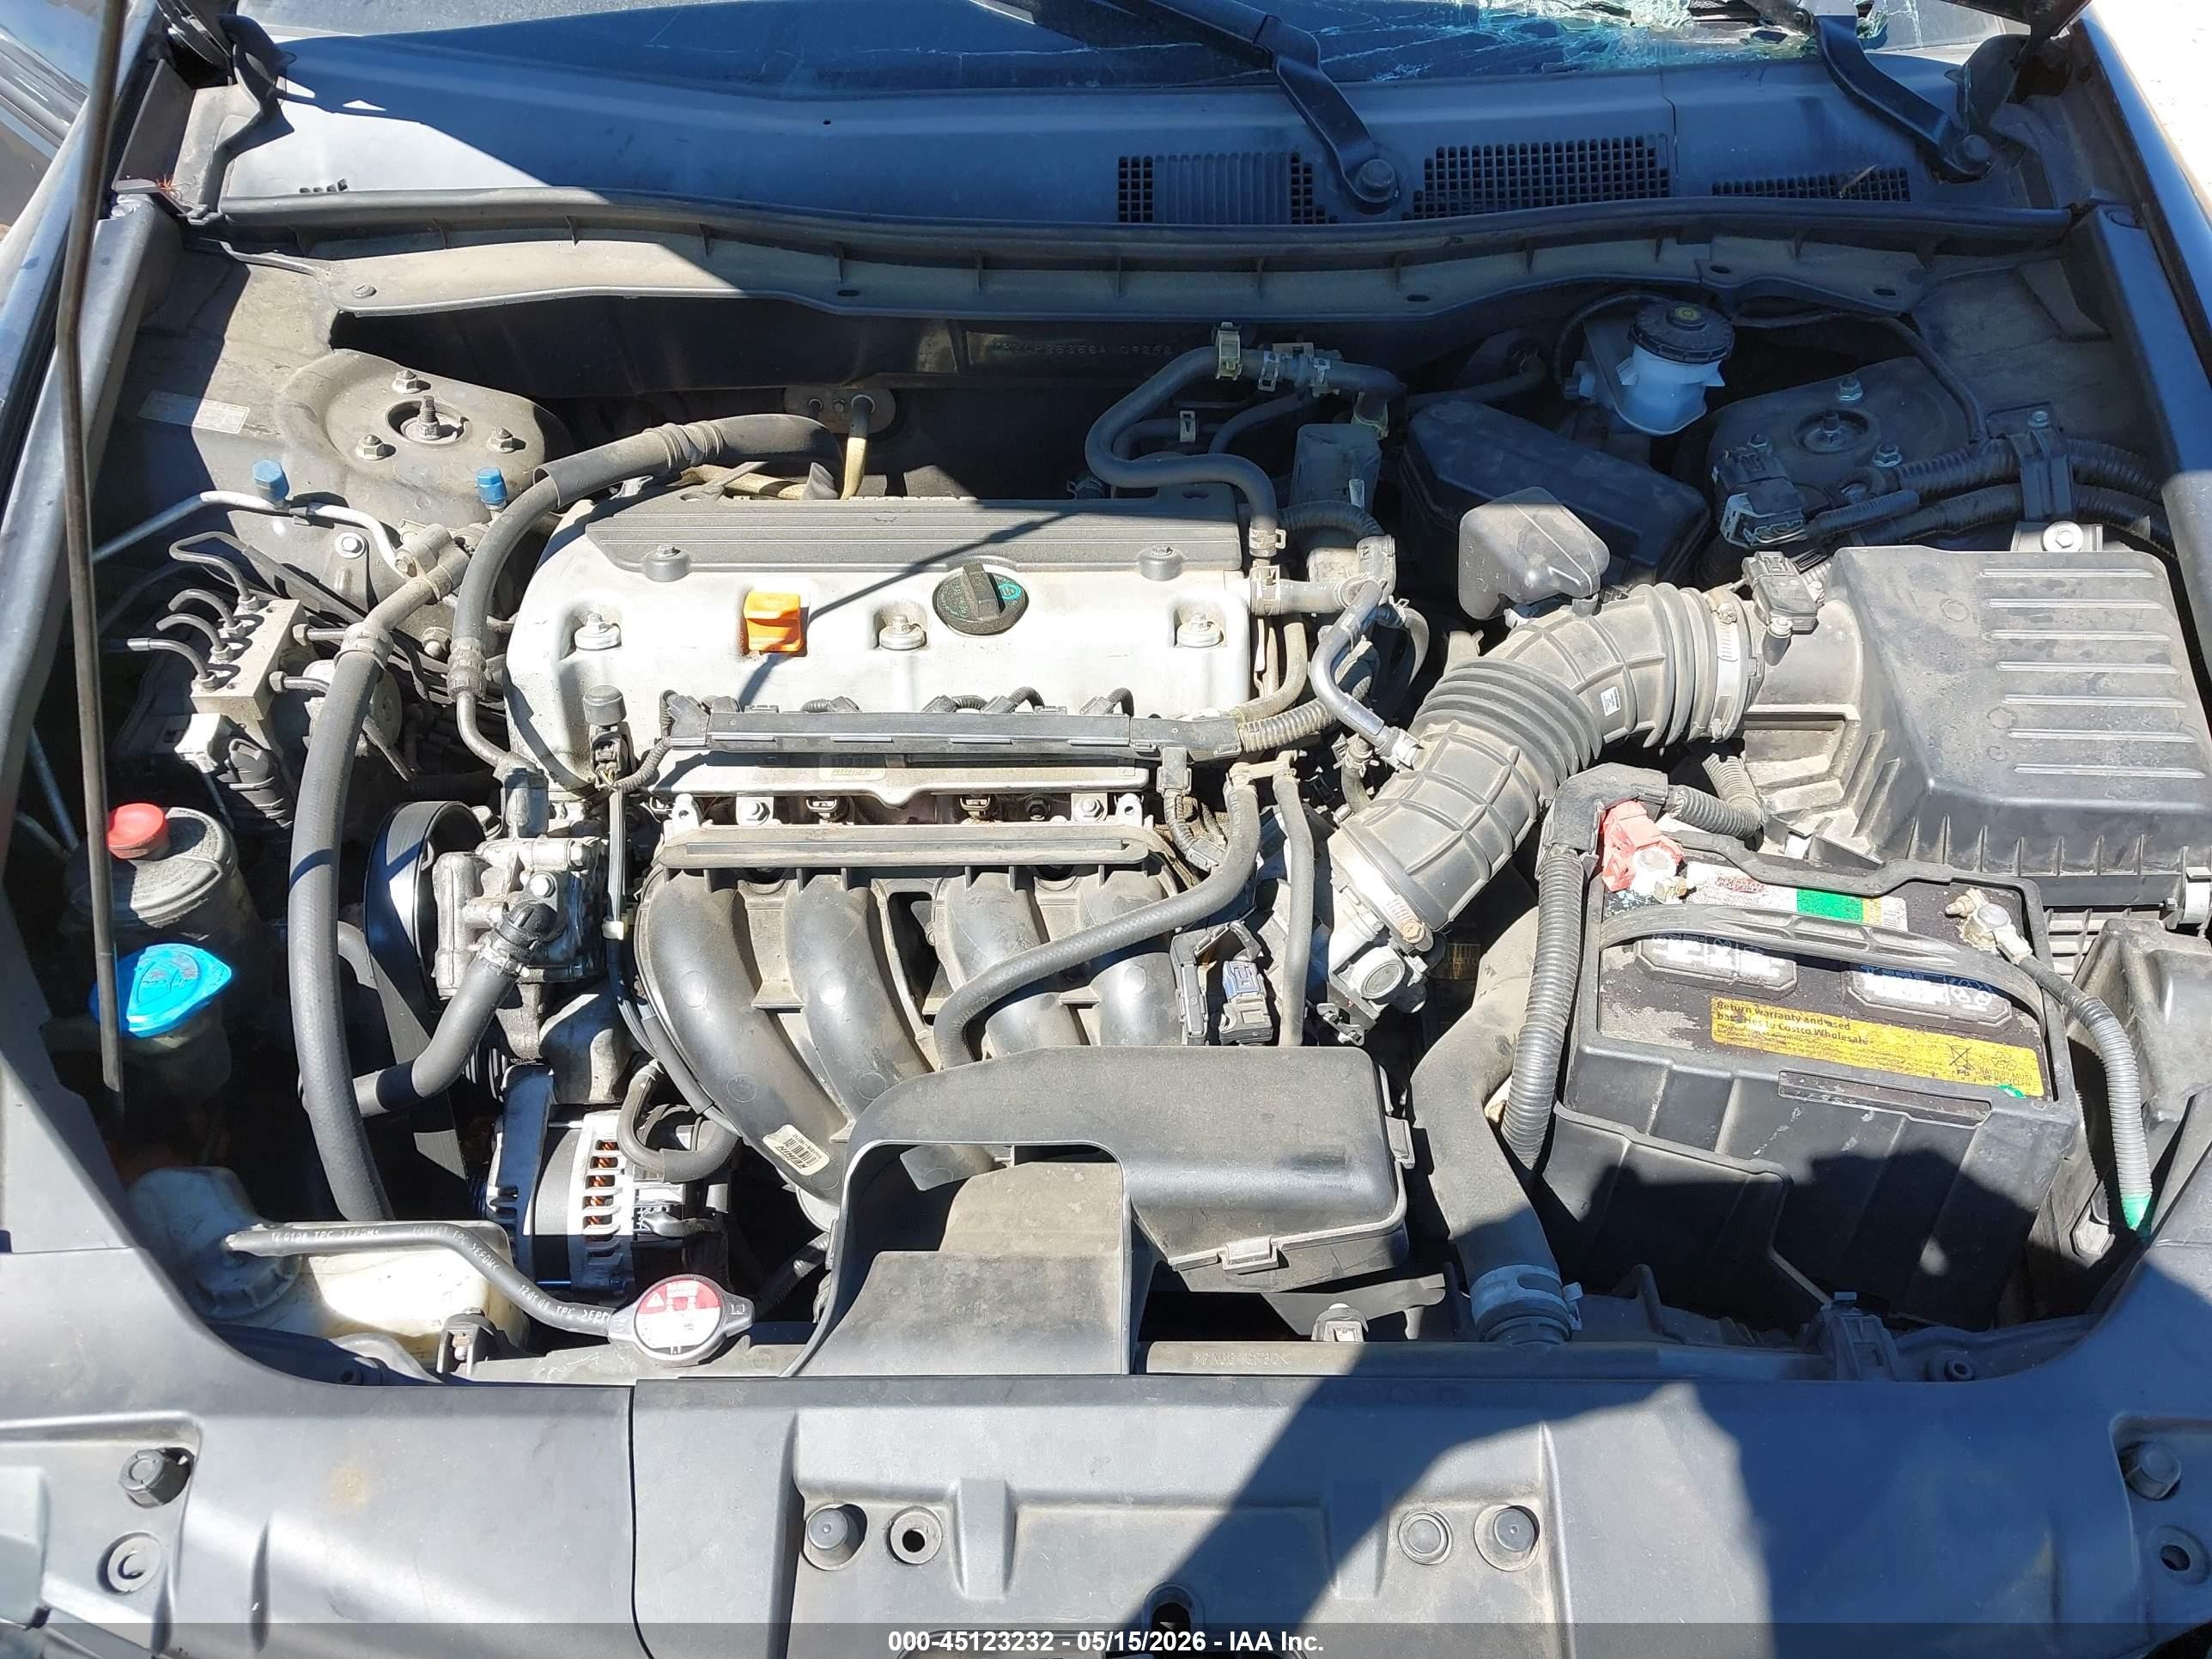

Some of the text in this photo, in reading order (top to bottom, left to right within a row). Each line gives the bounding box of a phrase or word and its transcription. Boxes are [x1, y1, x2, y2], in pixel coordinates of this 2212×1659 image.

[1717, 1000, 1753, 1013] Return
[1803, 1016, 1823, 1025] and
[1717, 1012, 1763, 1027] batries
[1778, 1023, 1811, 1035] Costco
[778, 1145, 809, 1169] KEIHIN
[729, 1304, 746, 1313] 1.1
[669, 1345, 682, 1355] 1.1
